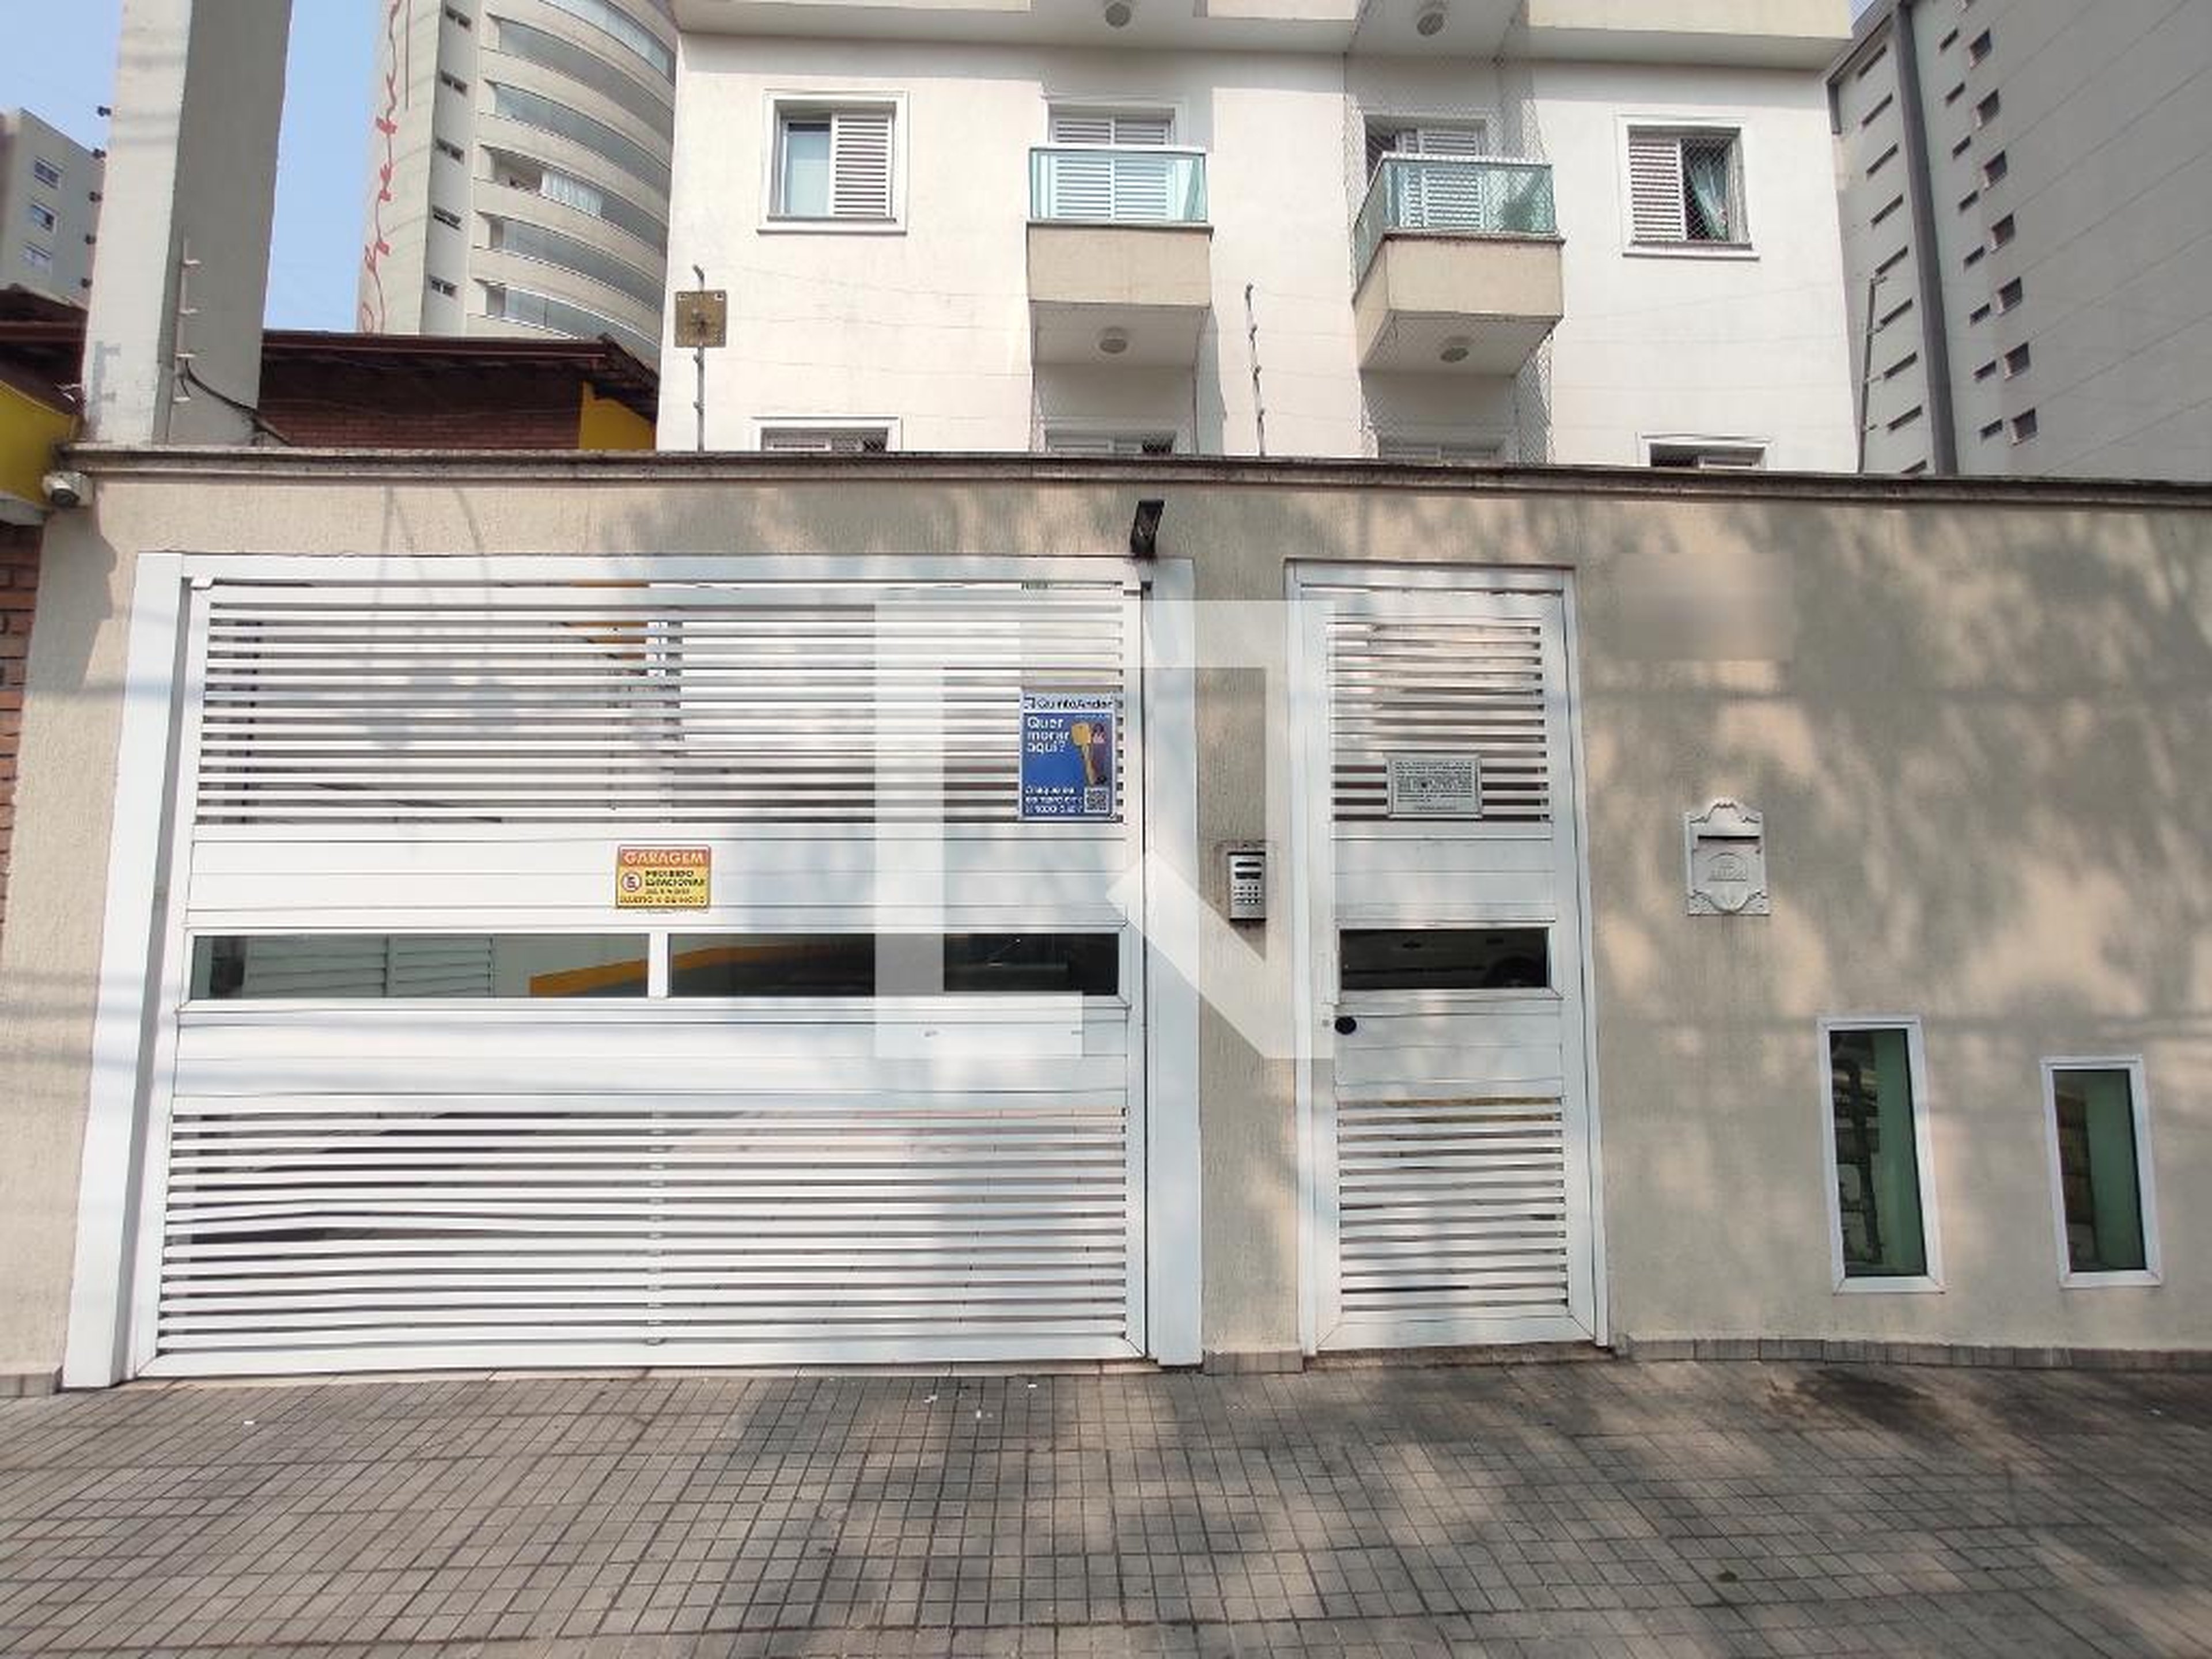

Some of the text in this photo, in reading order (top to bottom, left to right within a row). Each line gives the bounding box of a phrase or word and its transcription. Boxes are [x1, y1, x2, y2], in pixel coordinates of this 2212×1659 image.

[1027, 716, 1064, 729] Quer
[1027, 731, 1070, 740] morar
[1027, 741, 1066, 754] aqui?
[623, 851, 703, 865] GARAGEM
